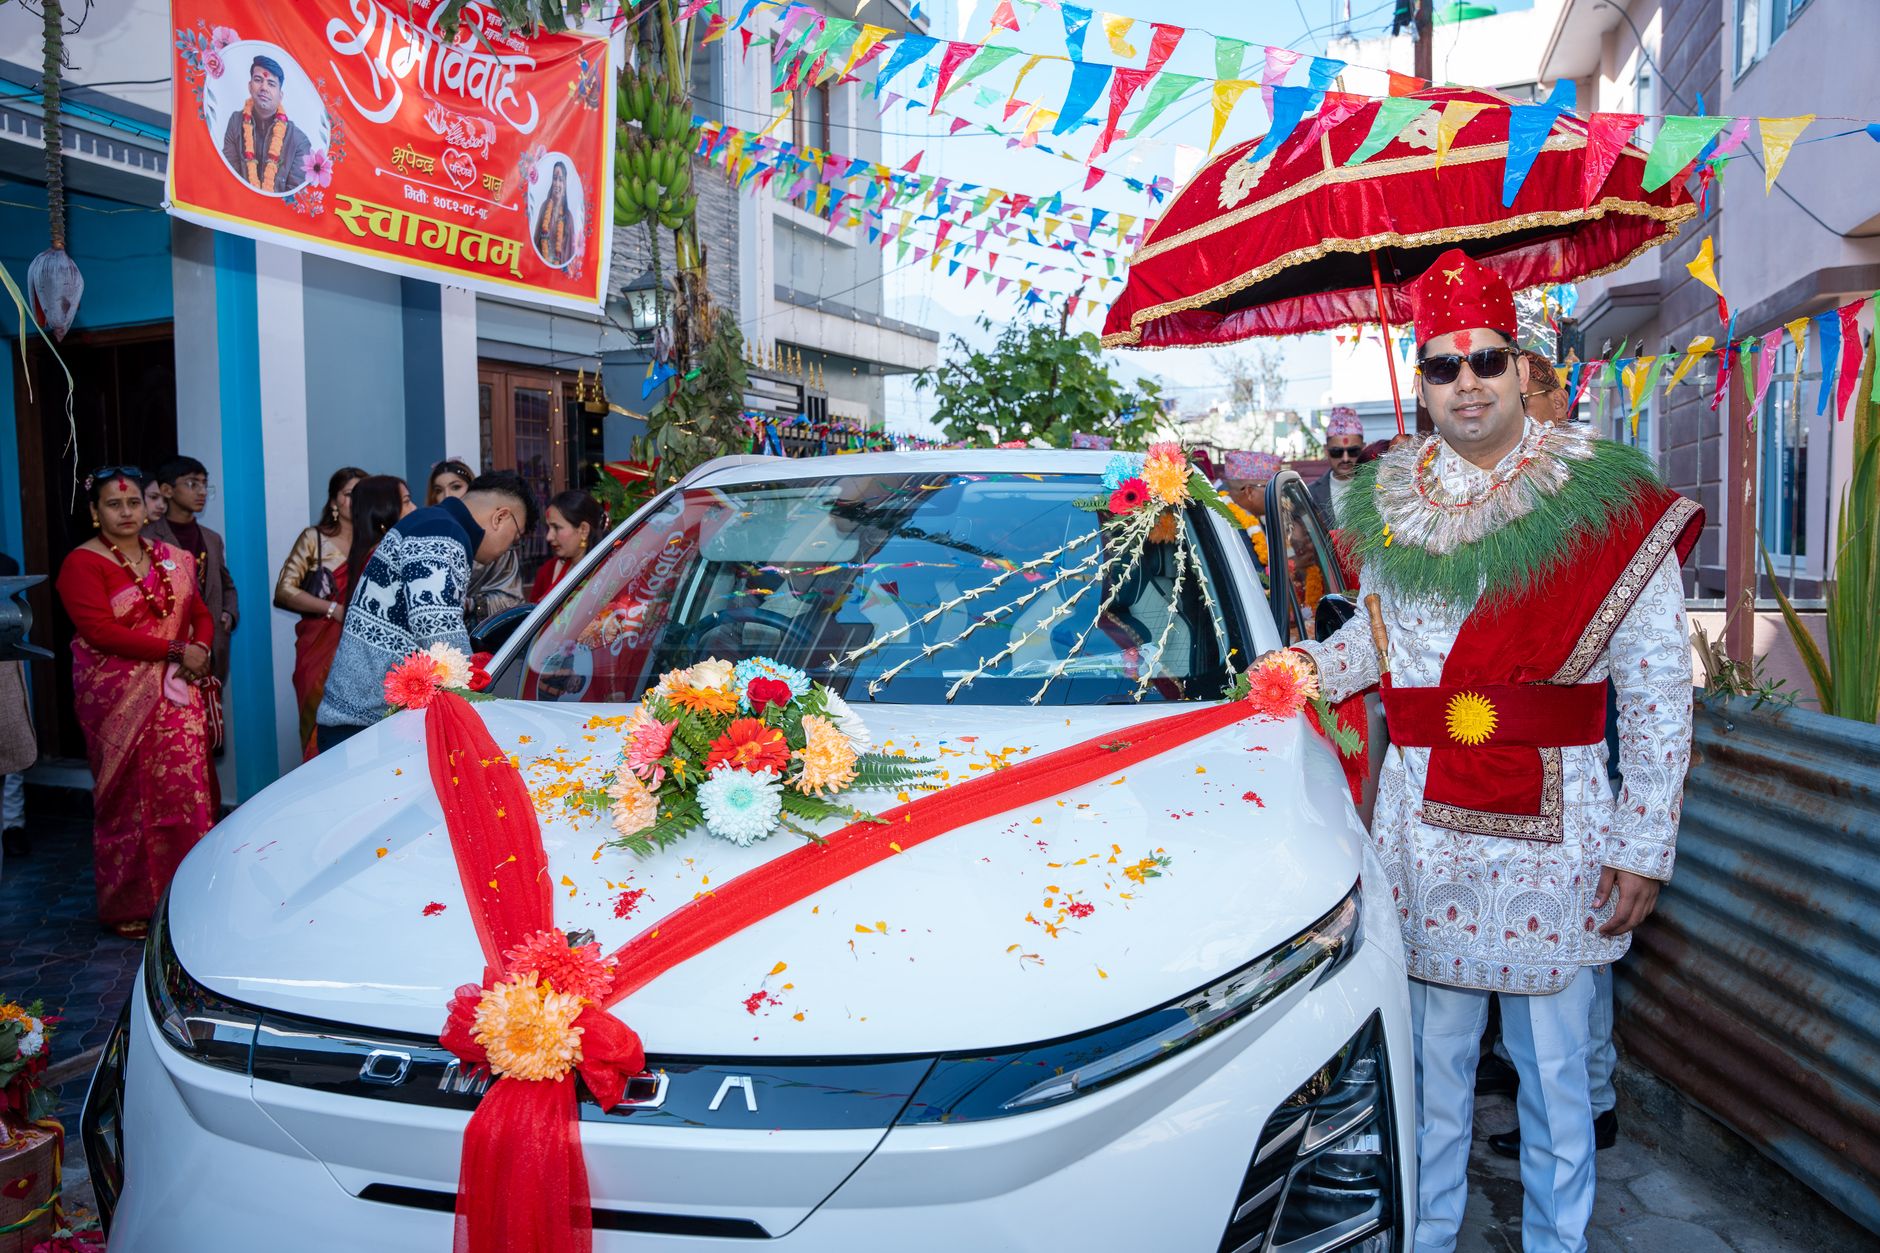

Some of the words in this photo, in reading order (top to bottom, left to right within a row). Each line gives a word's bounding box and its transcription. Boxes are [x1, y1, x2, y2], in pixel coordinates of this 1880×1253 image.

[391, 143, 435, 176] भूपेन्द्र
[334, 193, 524, 279] स्वागतम्
[359, 1048, 757, 1112] OMDA
